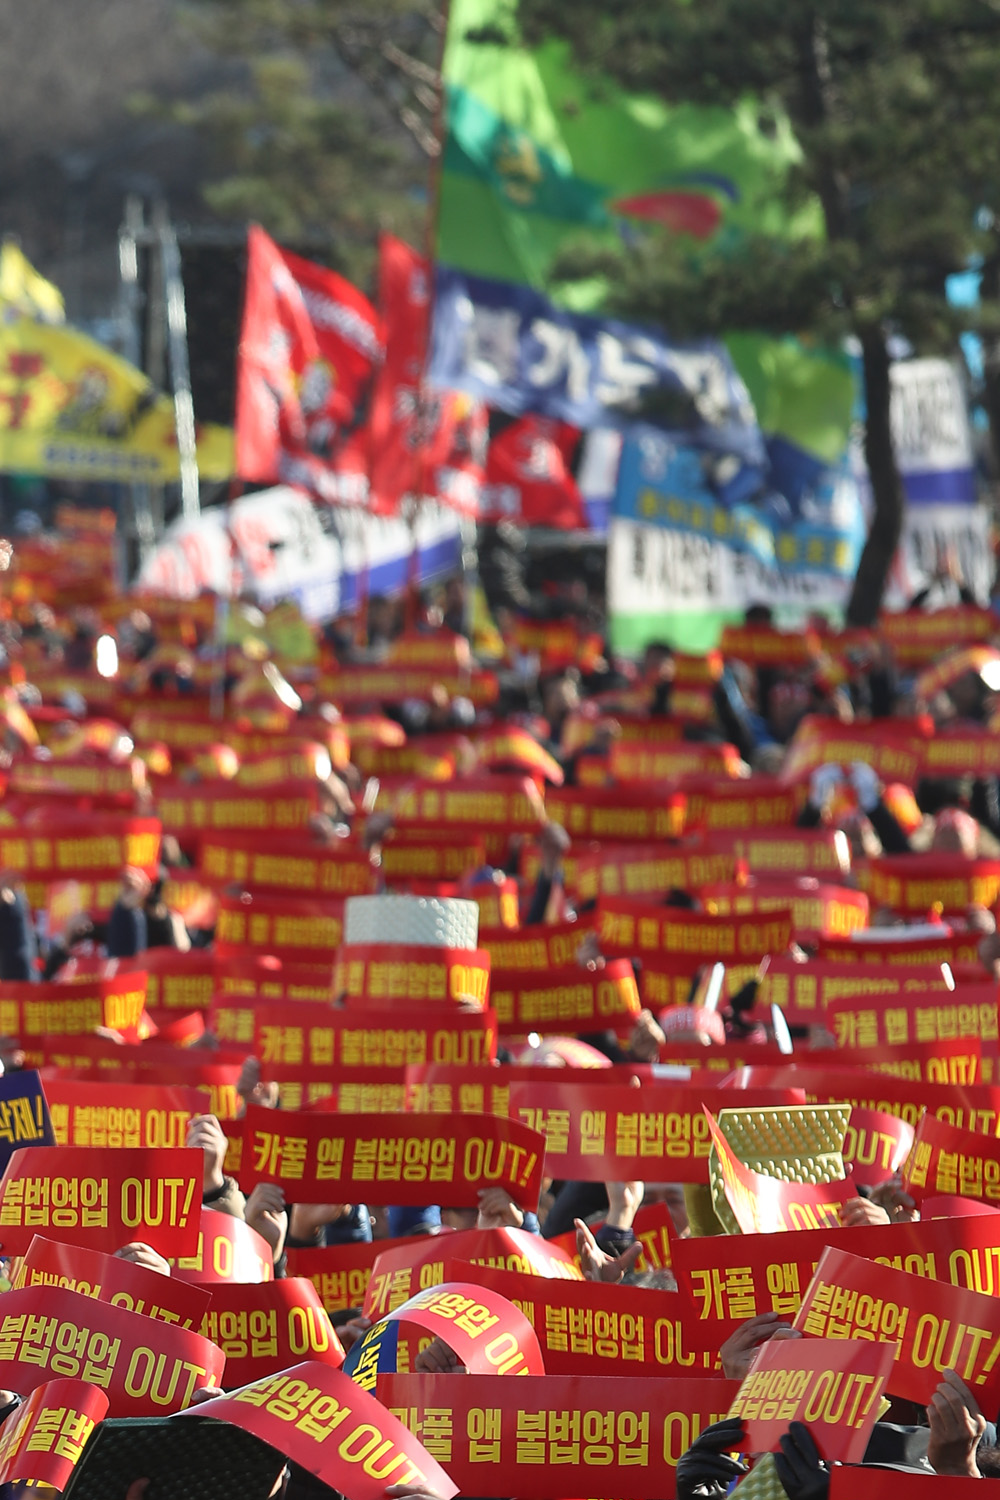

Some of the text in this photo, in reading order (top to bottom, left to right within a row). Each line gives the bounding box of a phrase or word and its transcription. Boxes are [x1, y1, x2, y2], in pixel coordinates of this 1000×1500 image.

[259, 1026, 305, 1063] 카풀
[309, 1028, 335, 1065] 앱
[340, 1029, 427, 1067] 불법영업
[252, 1130, 537, 1188] 카풀 앱 불법영업 OUT!
[580, 1110, 606, 1156] 앱
[0, 1171, 196, 1228] 불법영업 OUT!
[369, 1267, 412, 1314] 카풀
[690, 1262, 801, 1320] 카풀 앱
[544, 1305, 645, 1362] 불법영업
[911, 1313, 1000, 1385] OUT!
[803, 1370, 884, 1429] OUT!
[466, 1408, 501, 1464] 앱
[515, 1410, 649, 1466] 불법영업
